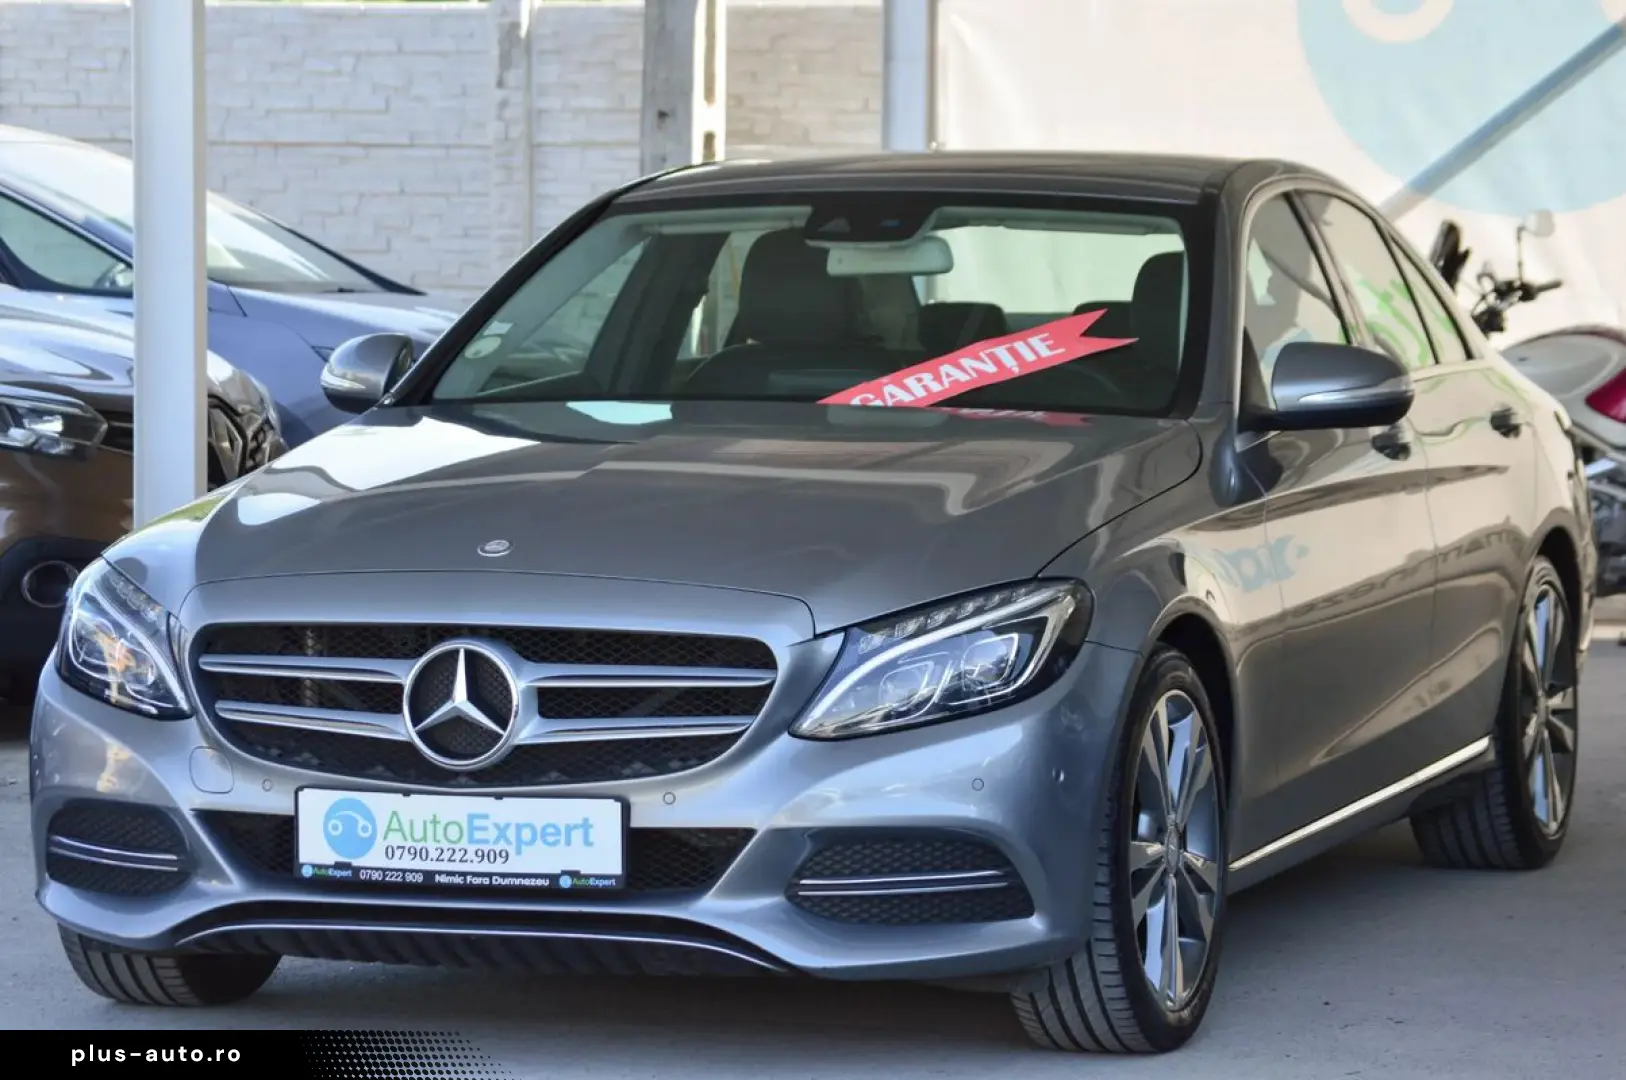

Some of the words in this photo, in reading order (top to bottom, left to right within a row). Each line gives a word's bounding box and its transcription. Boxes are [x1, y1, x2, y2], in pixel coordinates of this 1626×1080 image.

[383, 810, 594, 855] AutoExpert
[384, 844, 510, 865] 0790.222.909
[314, 867, 353, 878] AutoExpert
[359, 869, 382, 881] 0790
[385, 871, 403, 882] 222
[404, 872, 424, 883] 909
[435, 873, 464, 884] Nimic
[466, 875, 489, 885] Fara
[492, 875, 550, 886] Dumnezeu
[572, 876, 616, 888] AutoExpert
